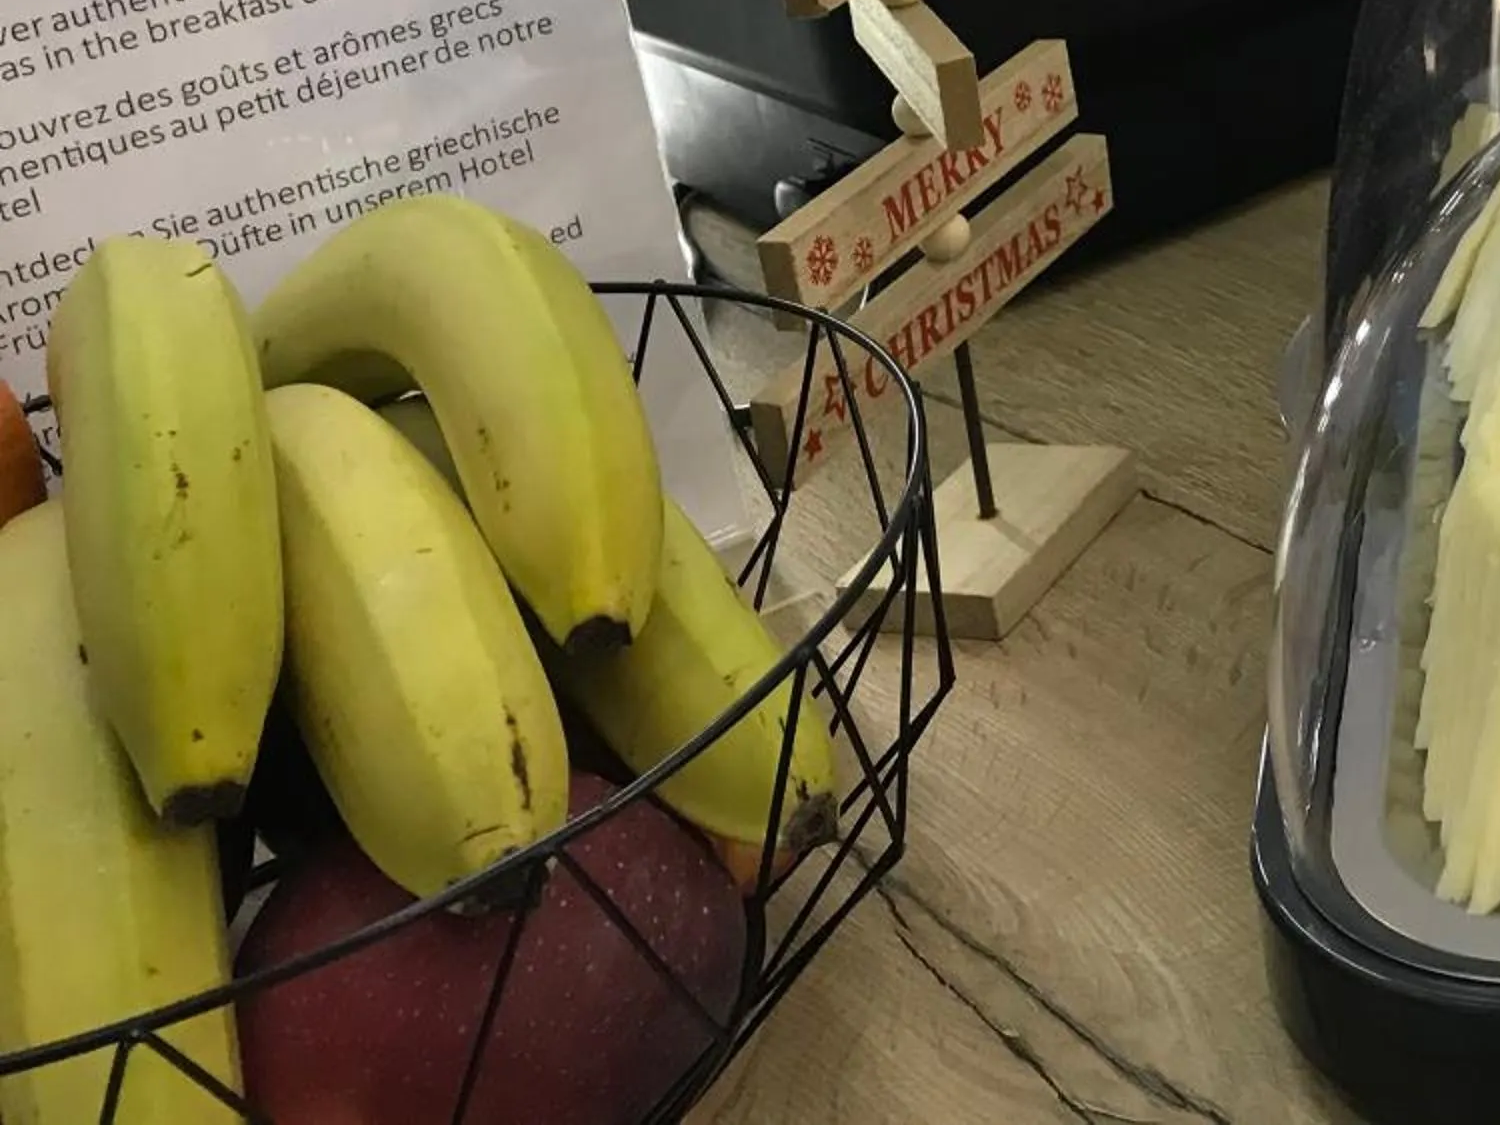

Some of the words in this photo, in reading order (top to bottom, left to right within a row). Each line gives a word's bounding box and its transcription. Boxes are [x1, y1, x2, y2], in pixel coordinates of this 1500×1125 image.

[42, 45, 75, 71] in
[82, 28, 140, 61] the
[115, 86, 173, 118] des
[181, 61, 269, 107] goûts
[274, 49, 306, 76] et
[313, 20, 422, 65] arômes
[171, 114, 209, 139] au
[215, 87, 290, 131] petit
[297, 50, 429, 103] déjeuner
[434, 38, 470, 64] de
[477, 15, 554, 52] notre
[152, 213, 200, 240] Sie
[206, 153, 401, 226] authentische
[407, 106, 561, 172] griechische
[289, 211, 316, 236] in
[325, 170, 453, 225] unserem
[458, 139, 535, 183] Hotel
[864, 203, 1062, 399] CHRISTMAS
